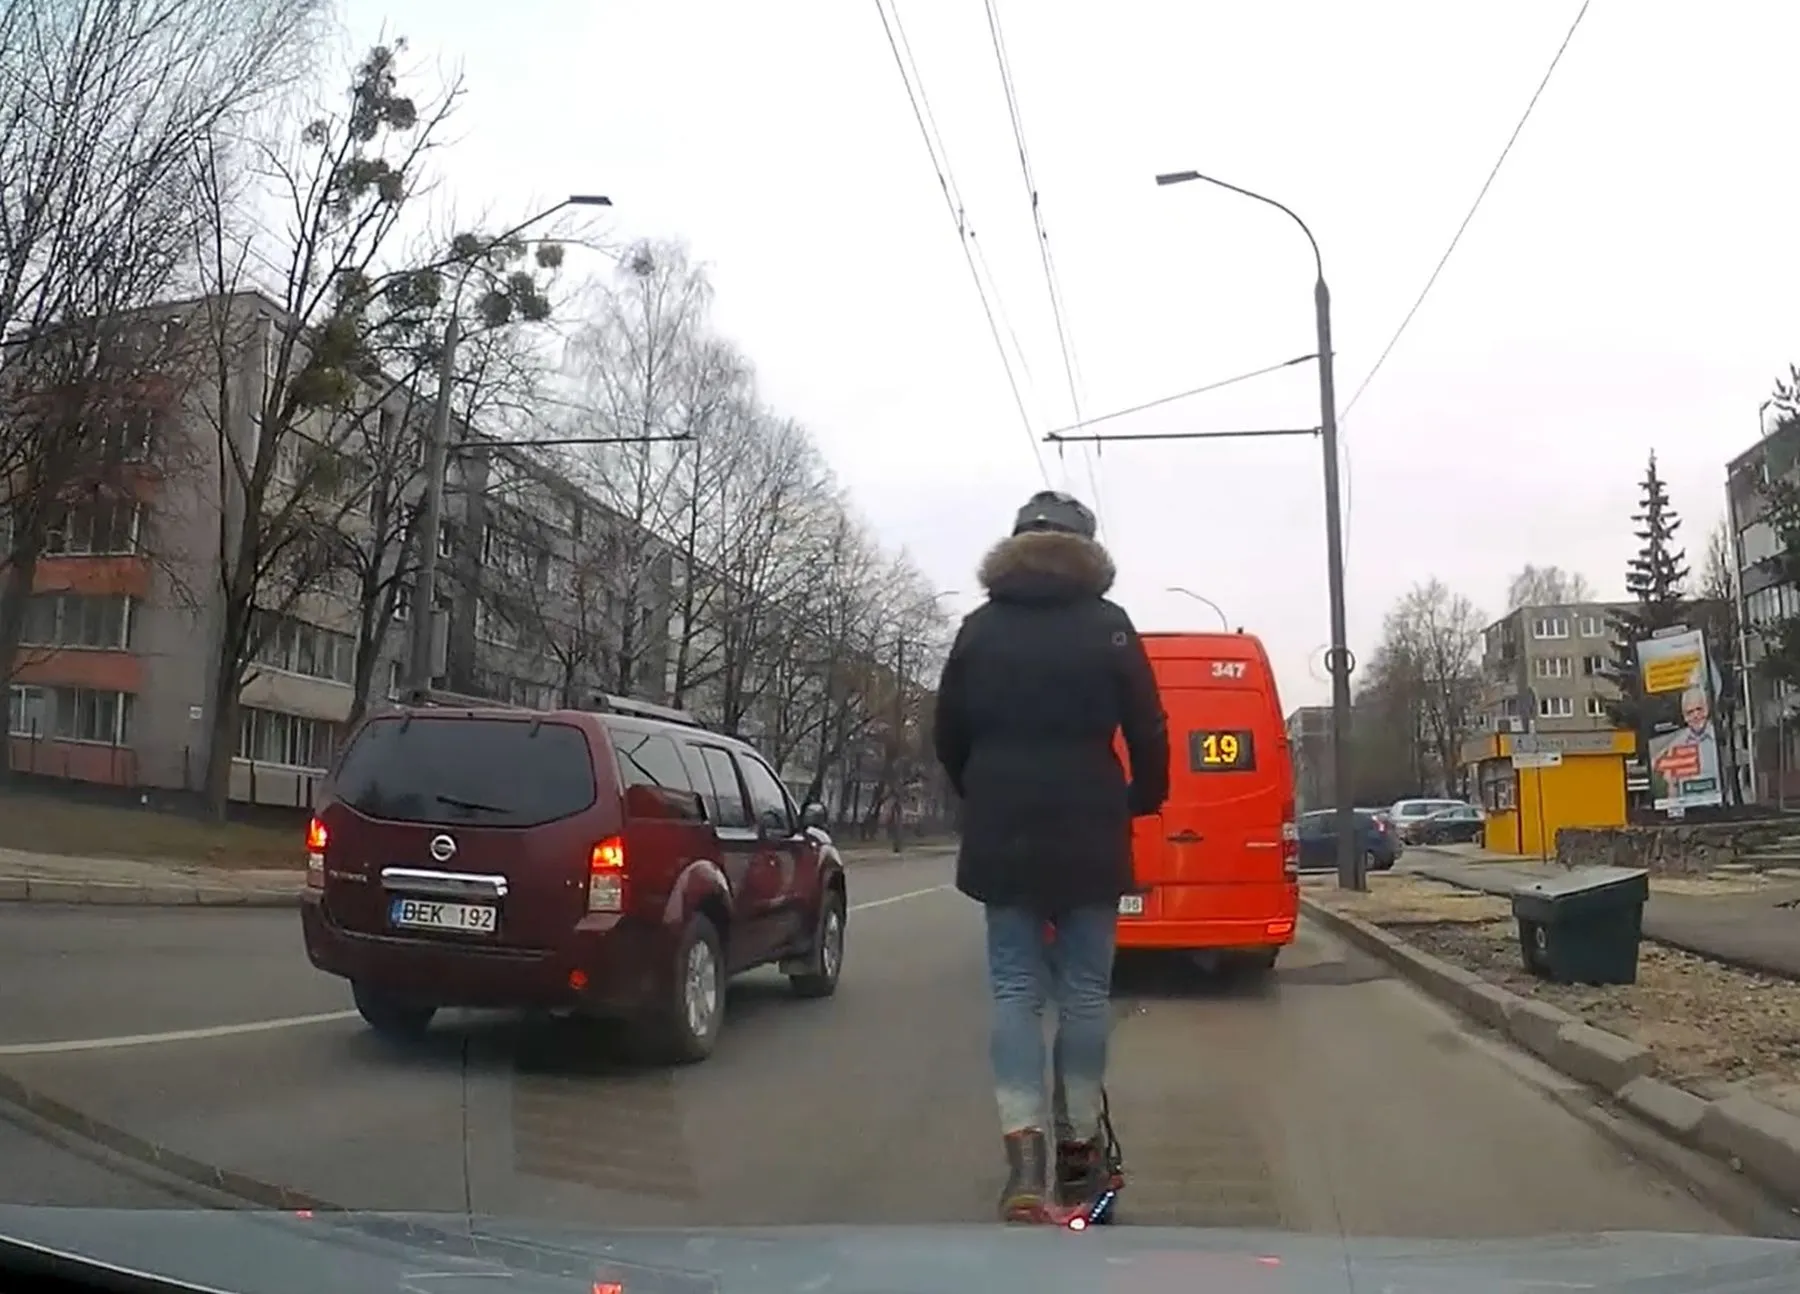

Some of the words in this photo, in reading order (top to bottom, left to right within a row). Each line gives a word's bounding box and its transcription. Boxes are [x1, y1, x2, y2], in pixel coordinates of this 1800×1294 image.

[1211, 661, 1247, 679] 347
[1203, 734, 1238, 763] 19
[460, 907, 493, 928] 192
